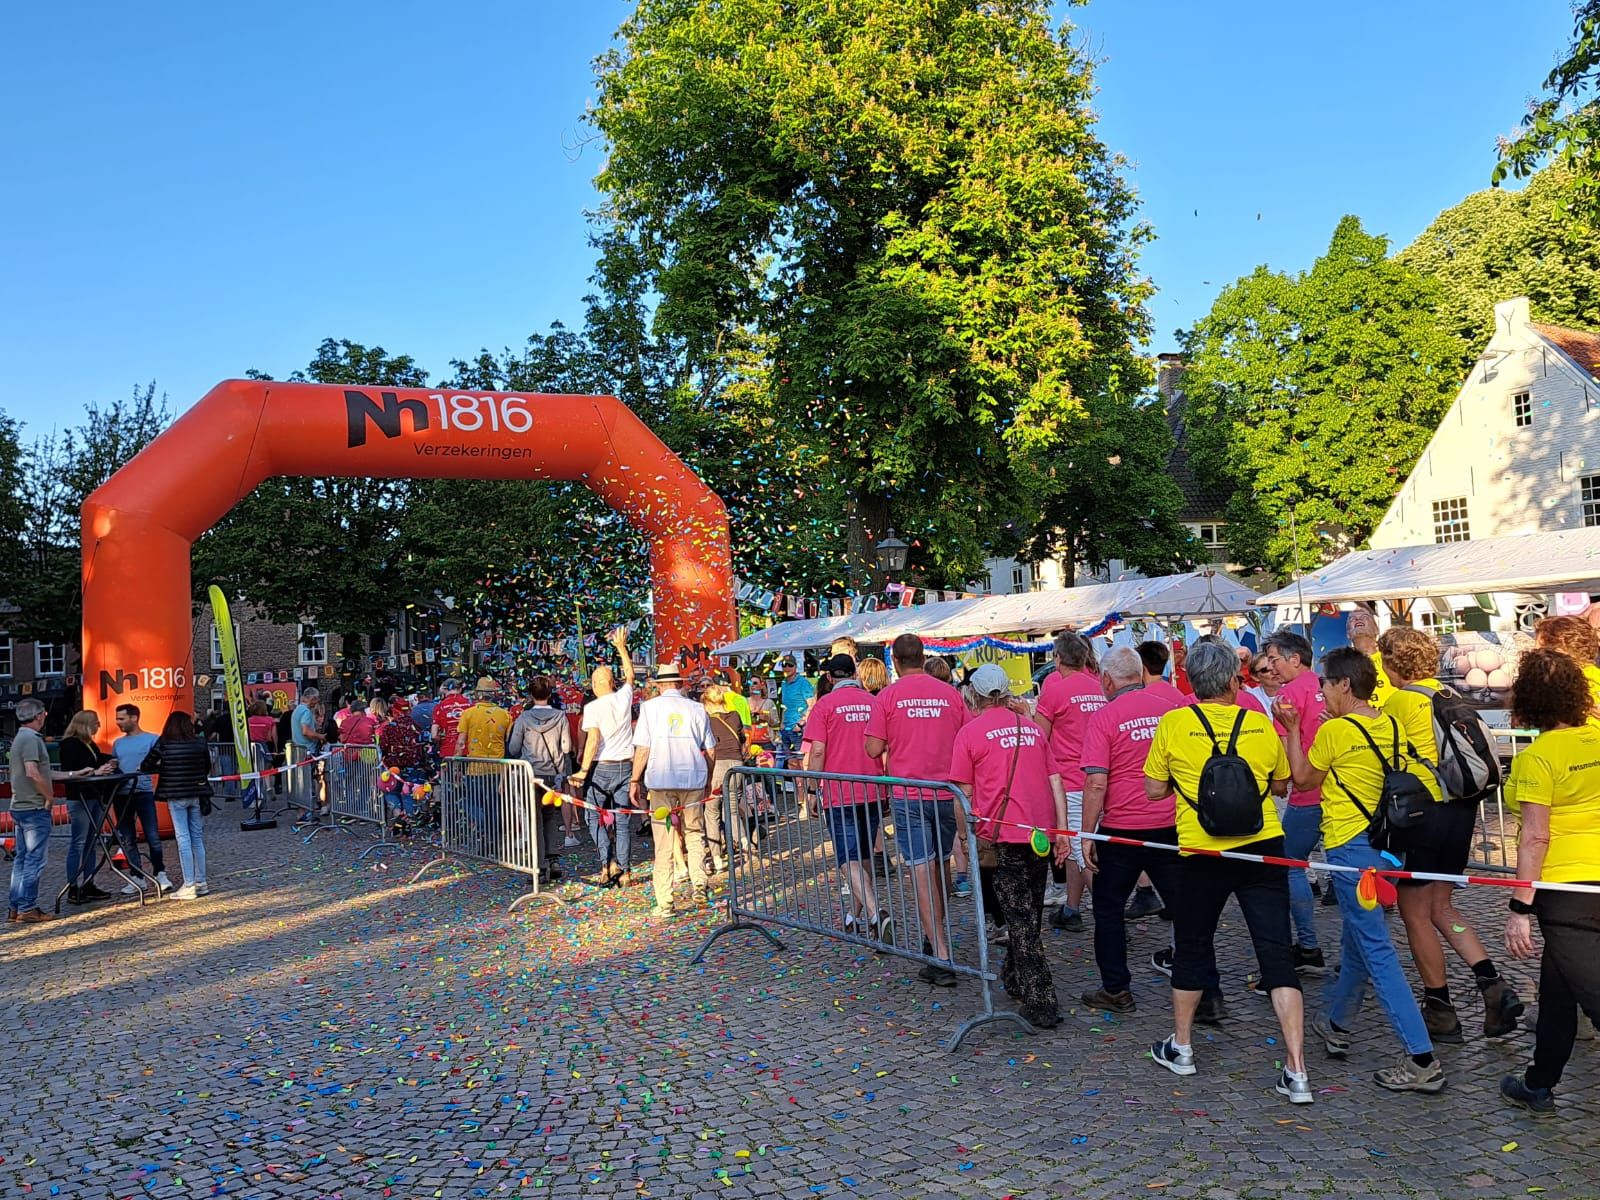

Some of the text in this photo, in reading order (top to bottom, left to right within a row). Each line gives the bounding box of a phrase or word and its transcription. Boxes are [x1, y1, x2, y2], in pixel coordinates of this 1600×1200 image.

[413, 443, 532, 459] Verzekeringen
[1283, 607, 1302, 621] 17
[897, 698, 950, 708] STUITERBAL
[907, 707, 941, 718] CREW
[1000, 735, 1035, 748] CREW
